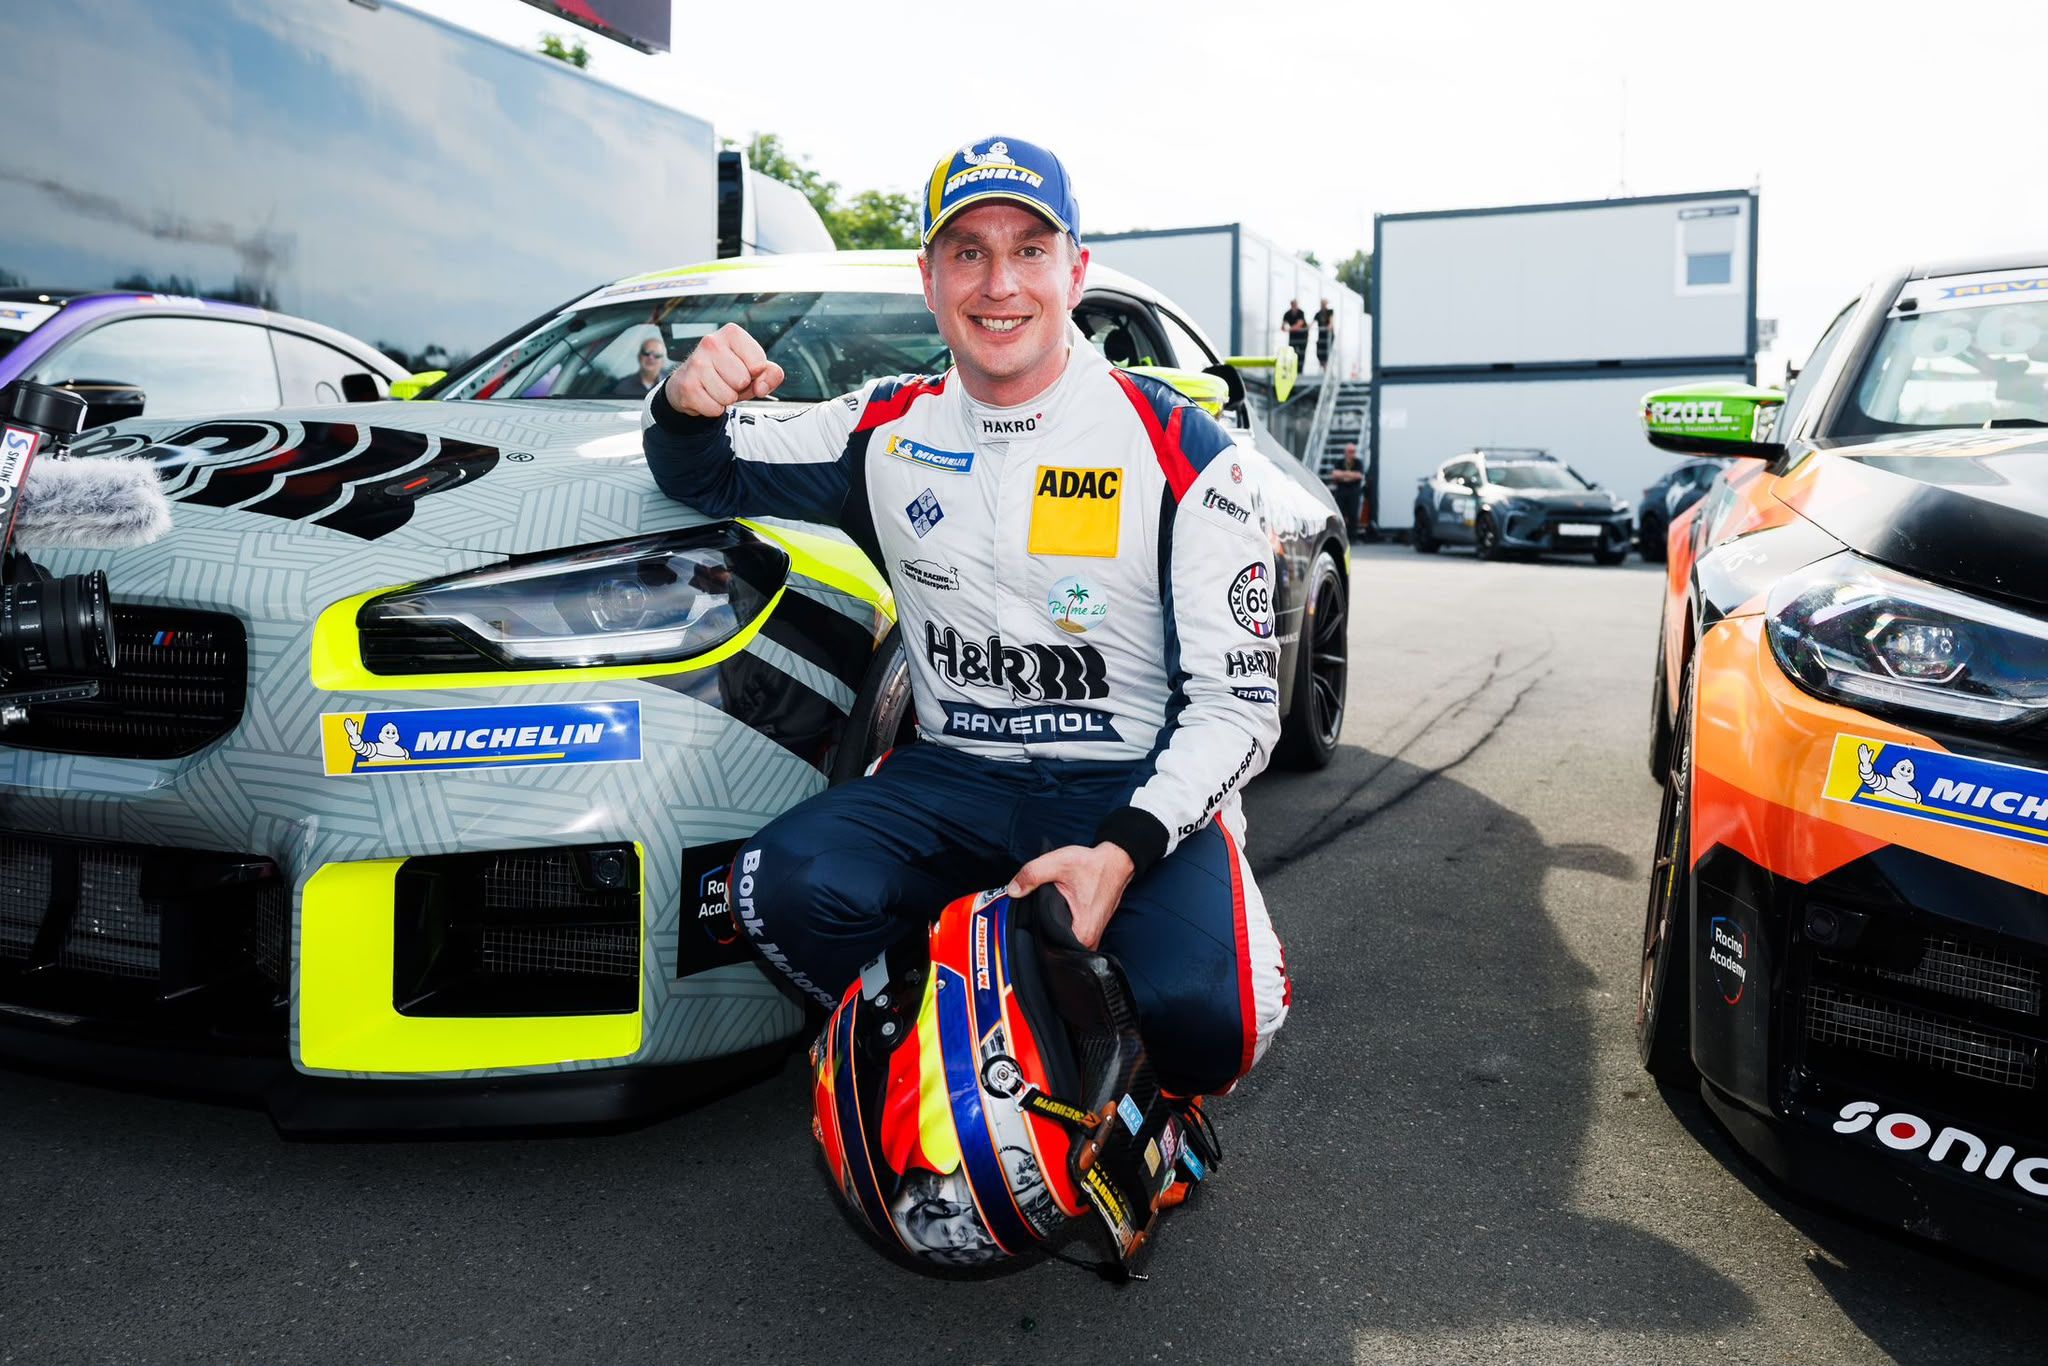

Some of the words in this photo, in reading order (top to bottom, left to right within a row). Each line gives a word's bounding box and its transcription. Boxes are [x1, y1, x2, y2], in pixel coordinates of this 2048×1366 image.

[944, 168, 1044, 196] MICHELIN
[983, 418, 1036, 433] HAKRO
[913, 450, 968, 468] MICHELIN
[1038, 470, 1118, 499] ADAC
[1205, 487, 1250, 524] freem
[1091, 602, 1107, 616] 26
[1231, 573, 1252, 626] HAKRO
[1246, 588, 1268, 613] 69
[925, 620, 1043, 703] H&R
[1226, 650, 1268, 678] H&R
[414, 723, 604, 752] MICHELIN
[952, 711, 1104, 735] RAVENOL
[1928, 777, 2048, 821] MICH
[739, 849, 764, 937] Bonk
[978, 917, 989, 967] SCHREY
[1715, 927, 1744, 959] Racing
[1709, 946, 1747, 982] Academy
